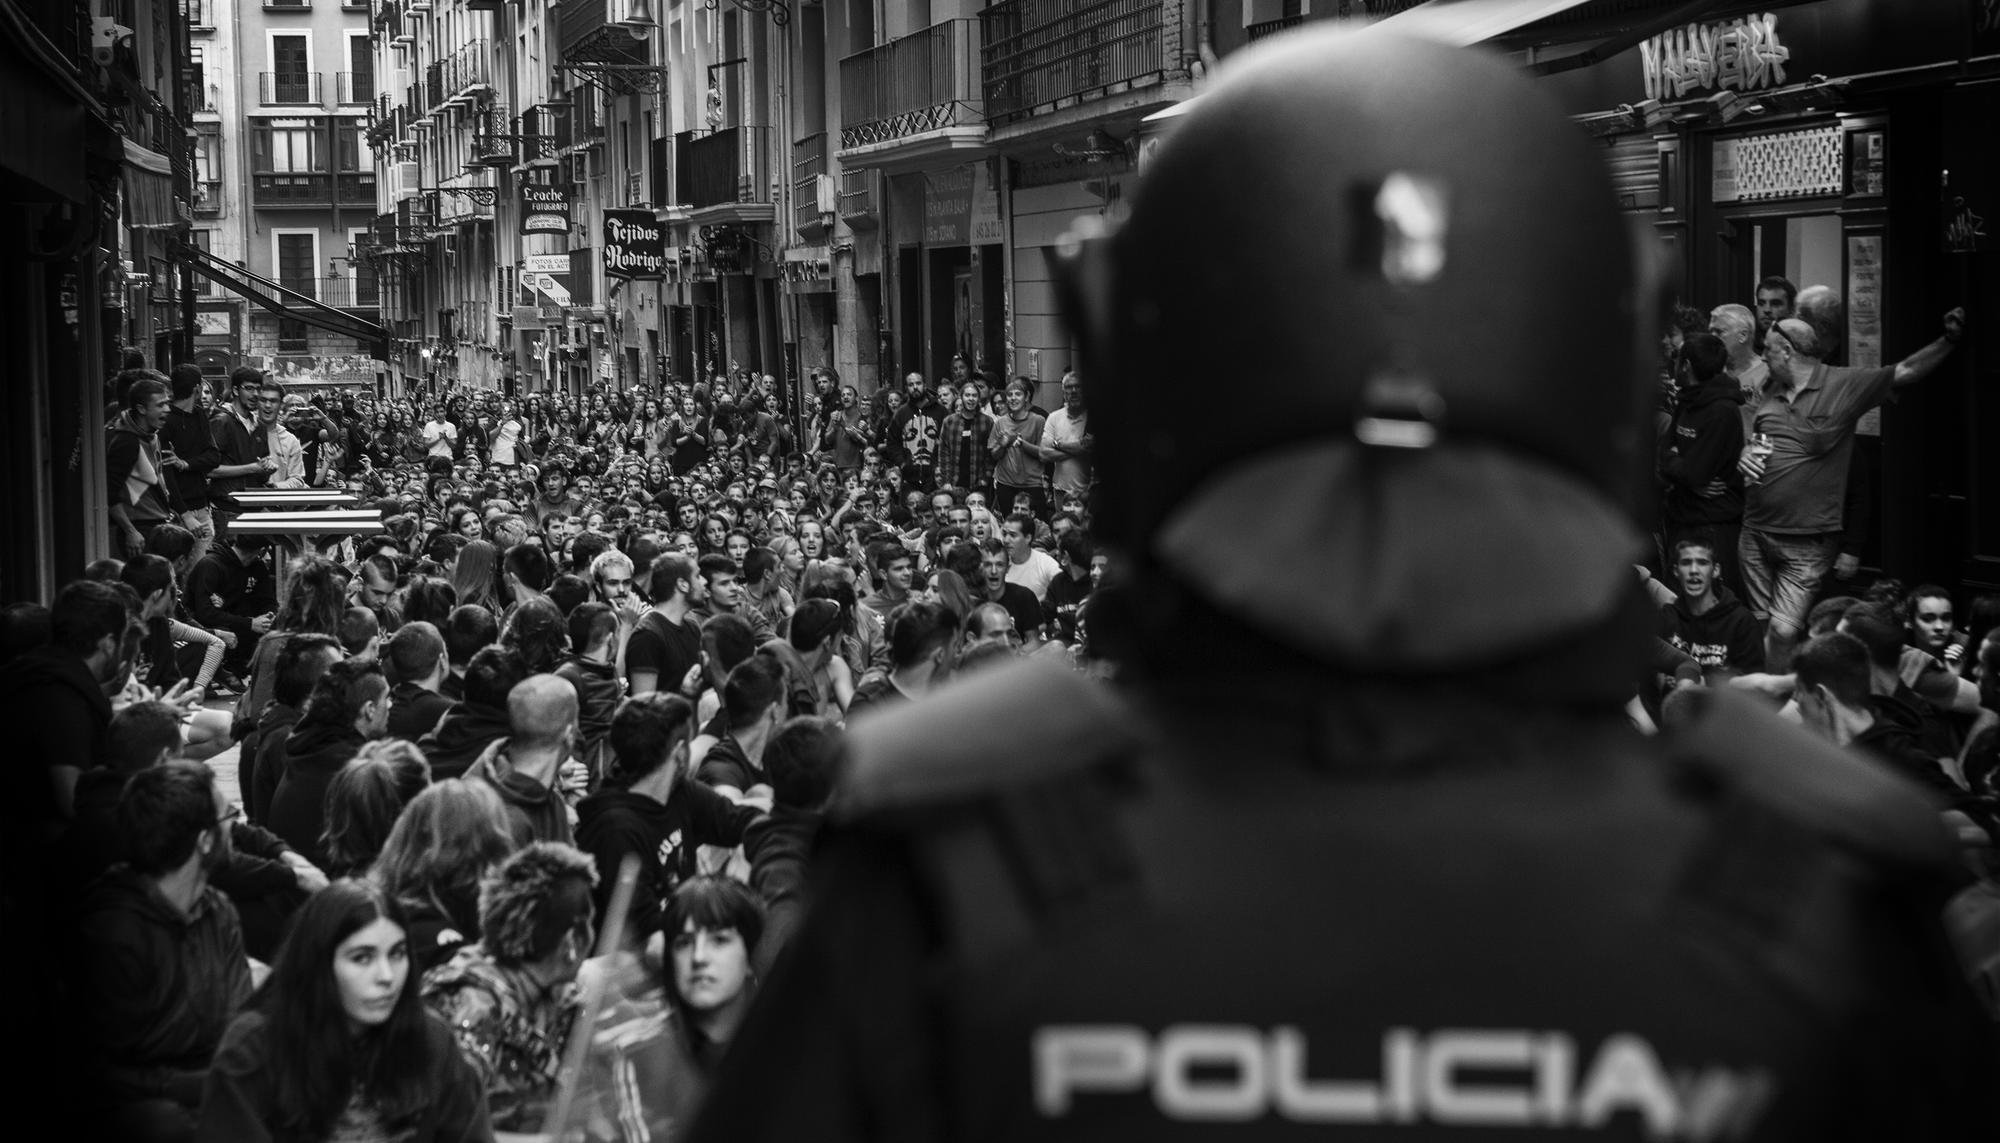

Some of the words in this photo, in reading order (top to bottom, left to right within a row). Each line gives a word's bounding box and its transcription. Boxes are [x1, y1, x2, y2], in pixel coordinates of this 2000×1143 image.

[524, 187, 564, 201] Leache
[607, 217, 660, 245] Tejidos
[605, 244, 663, 272] Rodrigo
[1032, 1025, 1674, 1134] POLICIA
